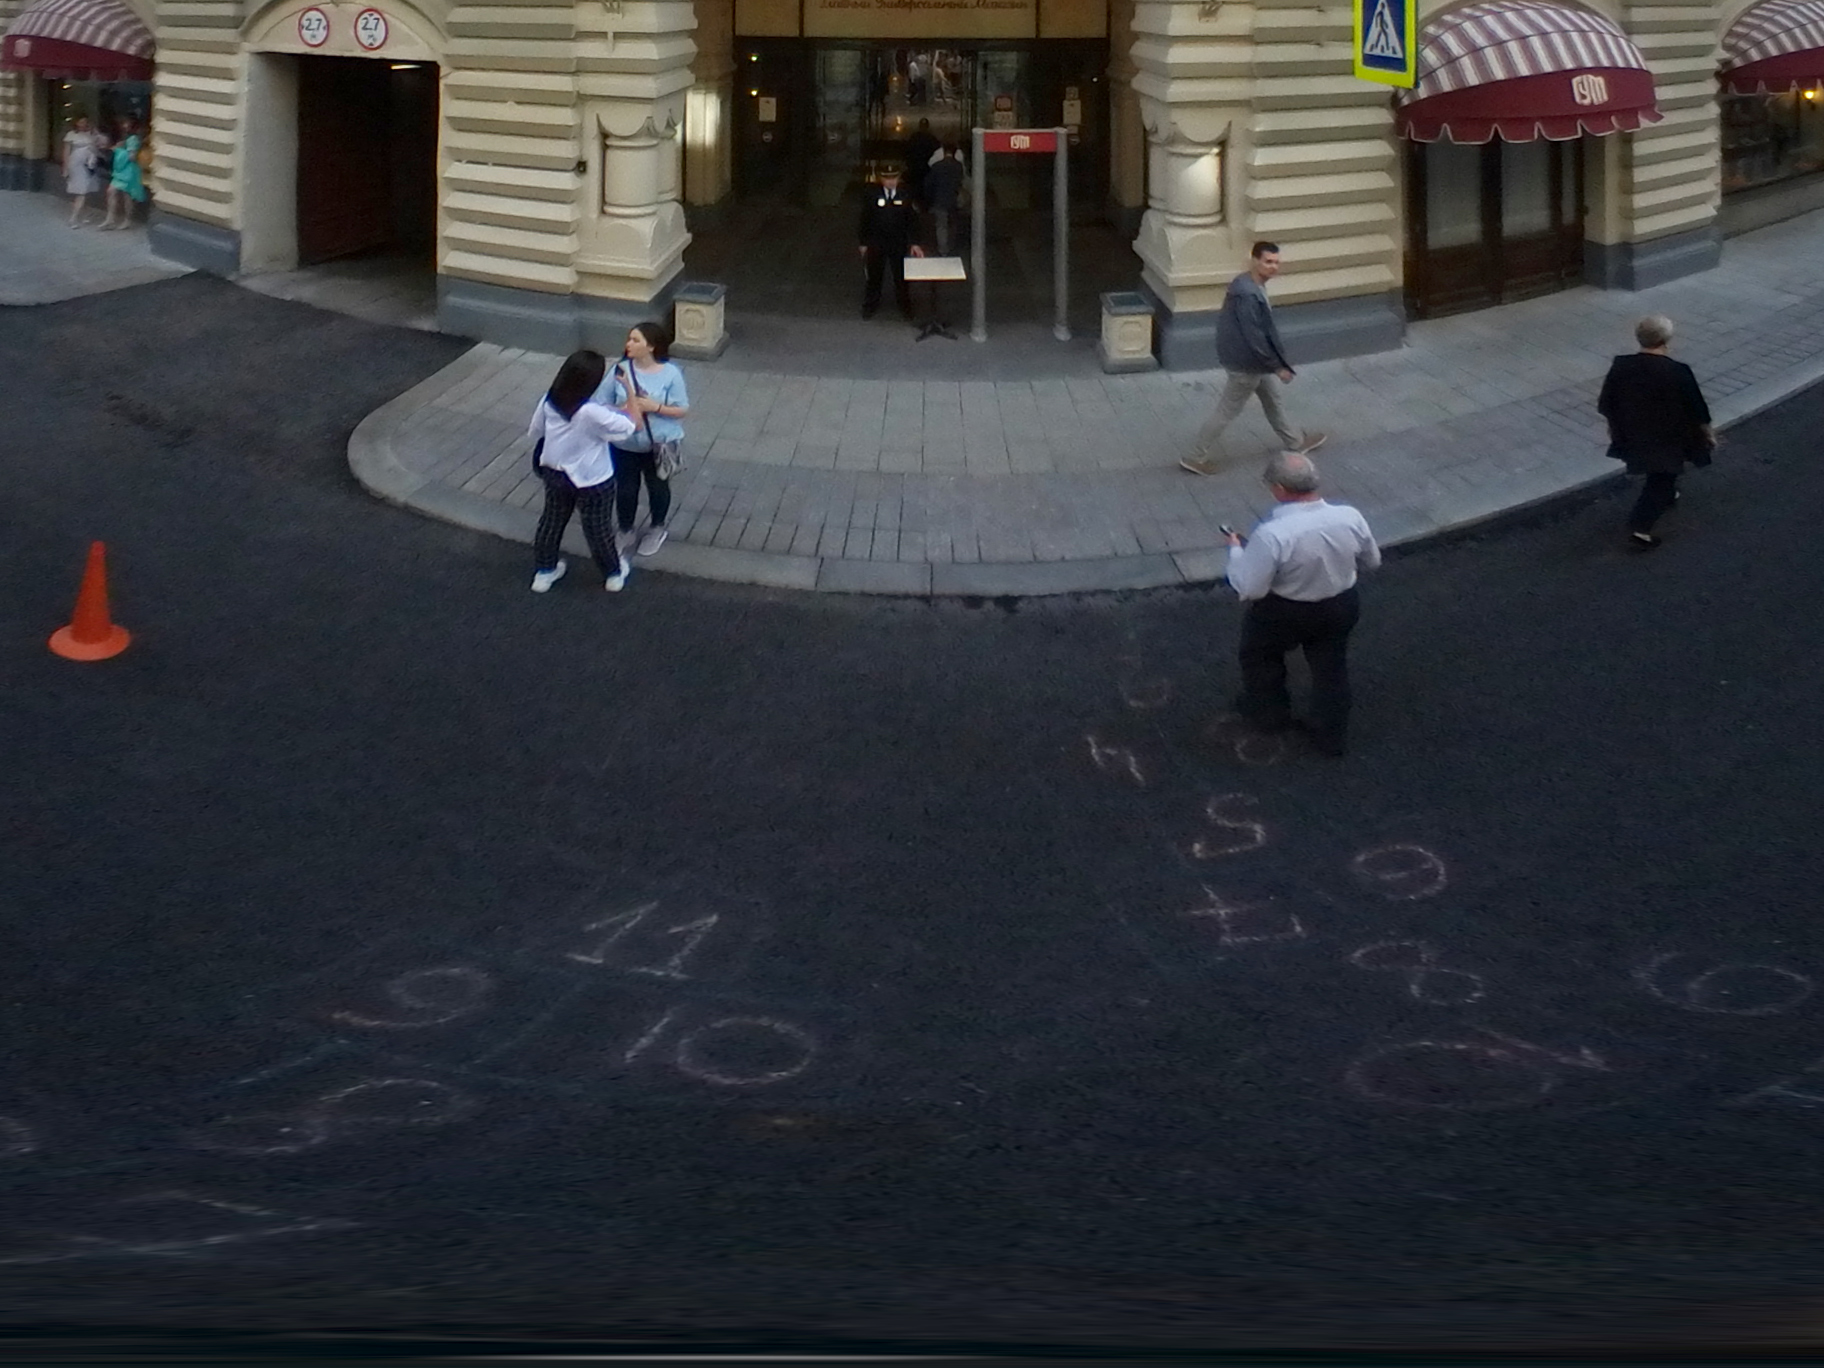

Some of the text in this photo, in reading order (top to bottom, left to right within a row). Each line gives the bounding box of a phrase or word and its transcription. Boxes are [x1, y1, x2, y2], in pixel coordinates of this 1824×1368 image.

[1571, 74, 1609, 106] ГУМ
[1010, 135, 1030, 149] ГУМ
[564, 899, 720, 980] 11
[622, 1007, 819, 1087] 10
